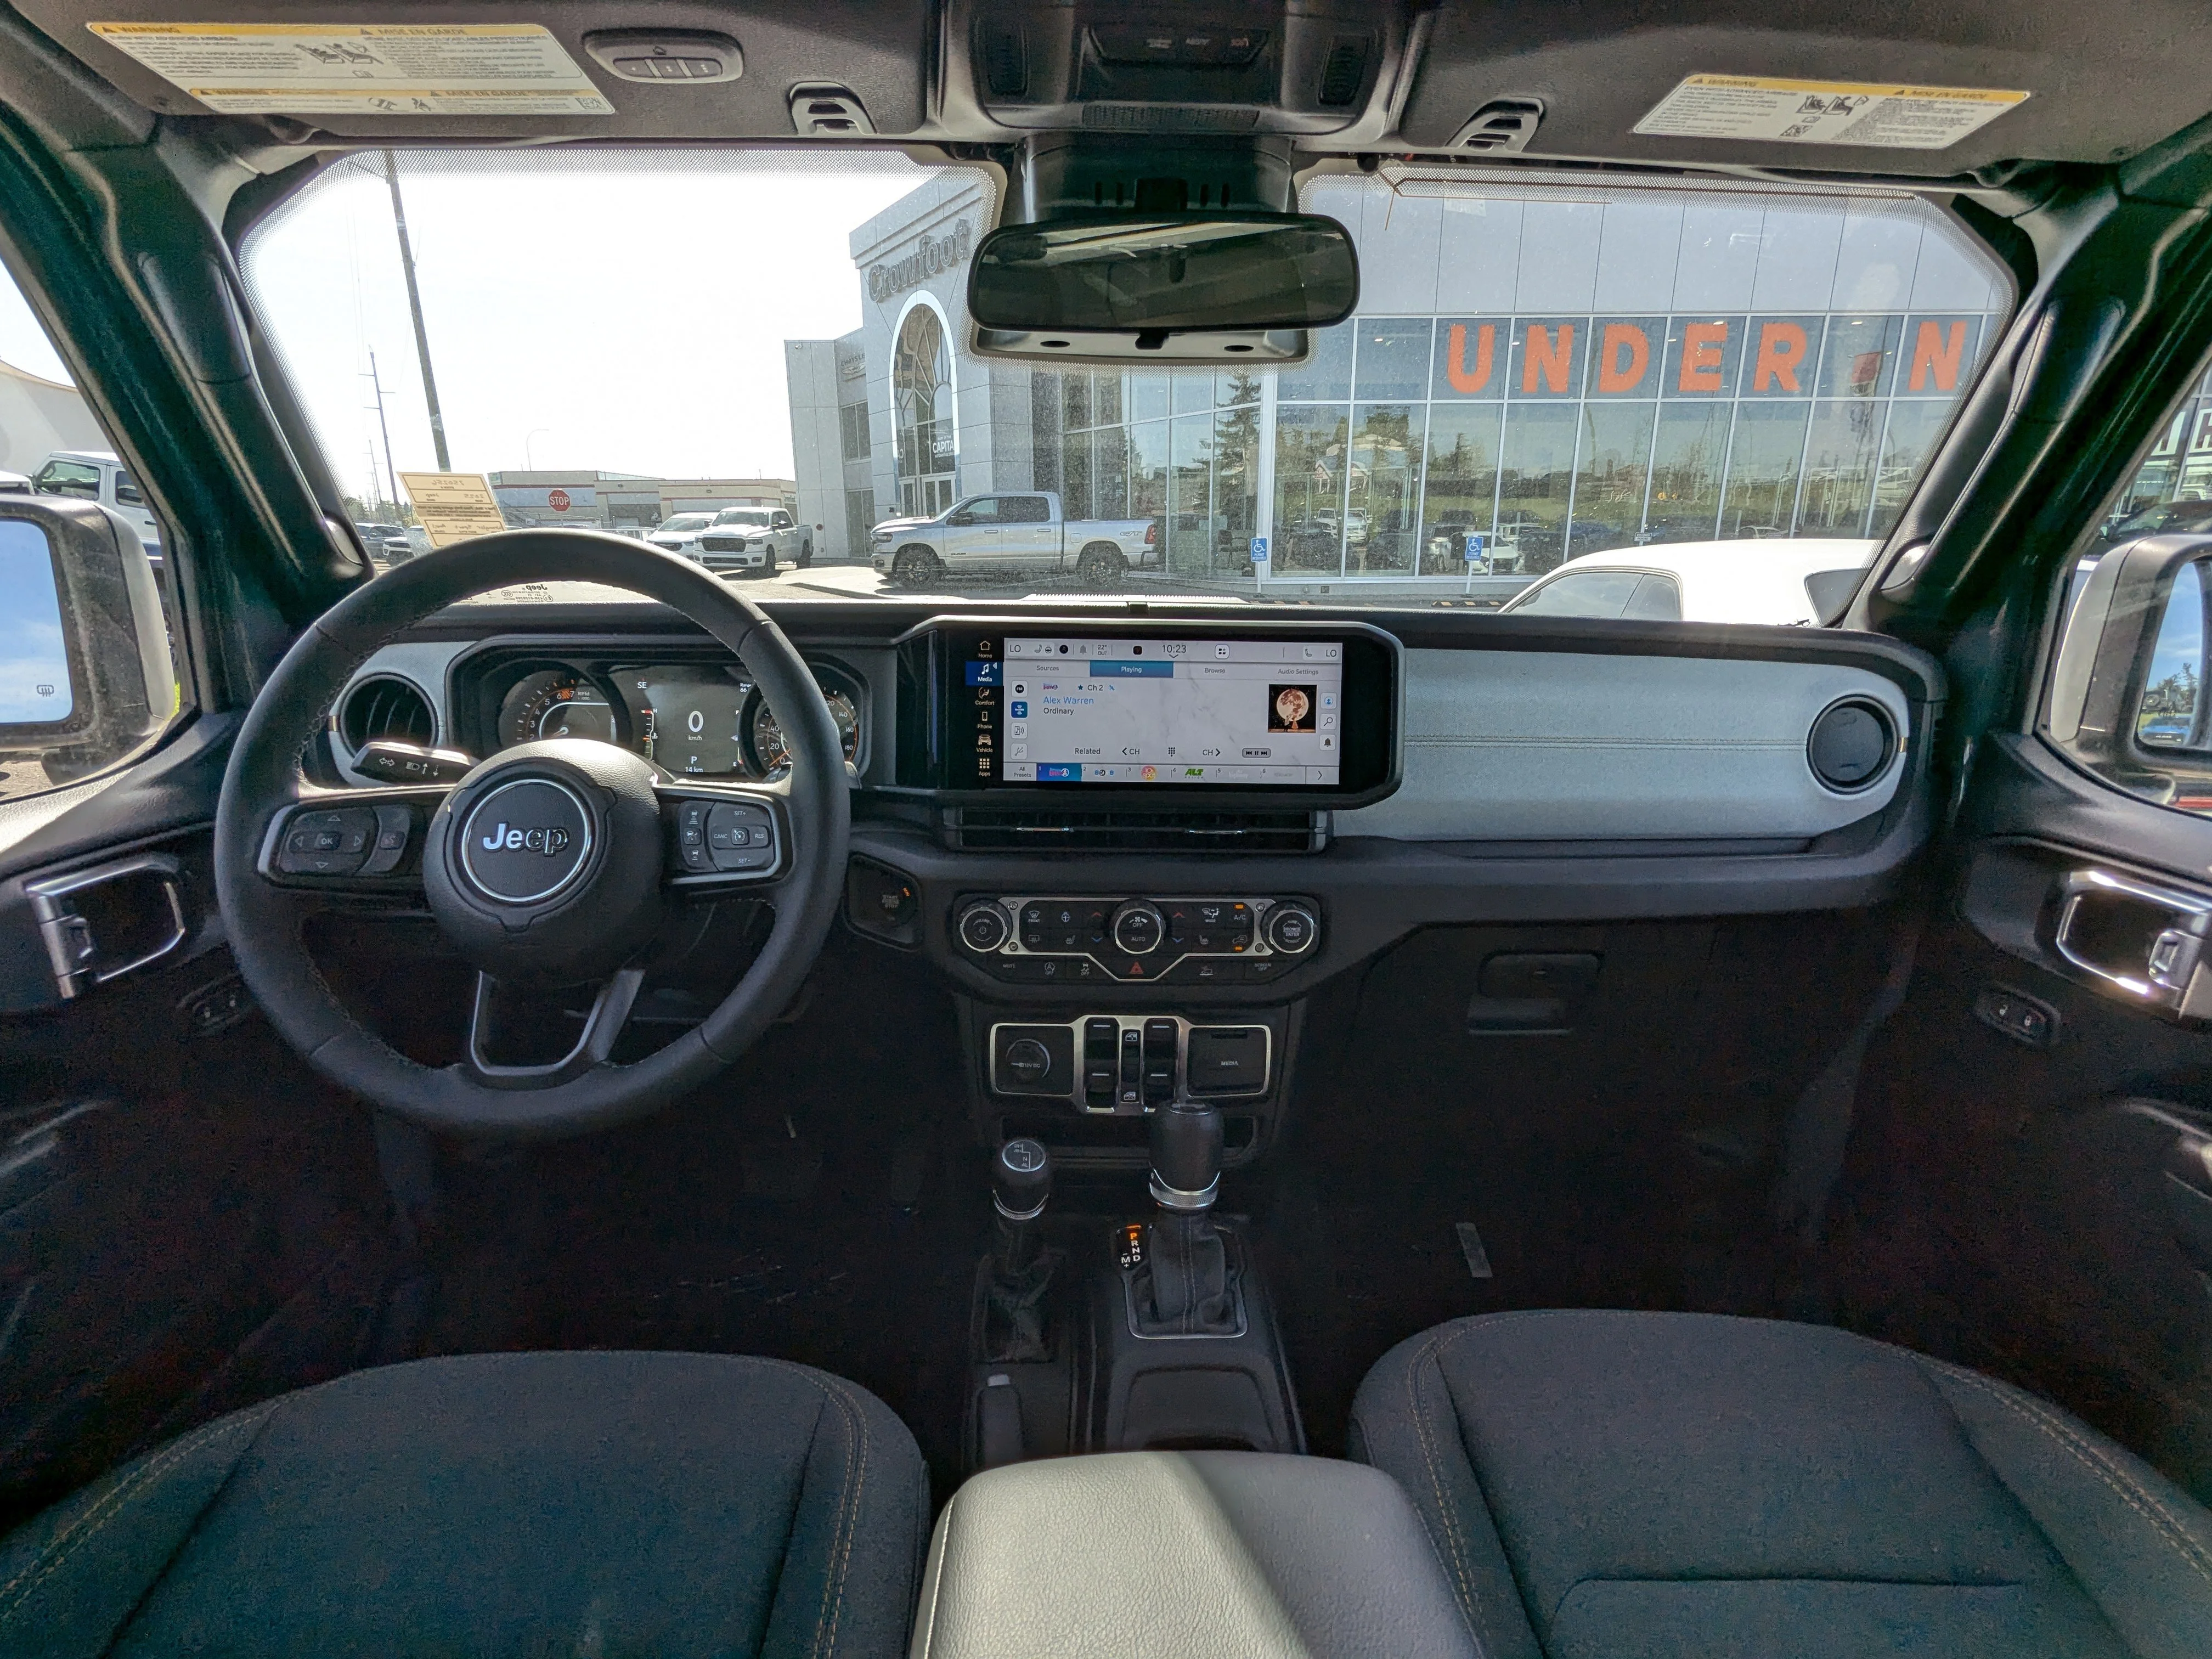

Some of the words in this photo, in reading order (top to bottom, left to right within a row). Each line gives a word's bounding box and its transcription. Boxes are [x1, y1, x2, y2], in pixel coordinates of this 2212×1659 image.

[868, 218, 970, 302] Crowfoot
[840, 353, 865, 367] CHRYSLE
[1447, 323, 1808, 393] UNDER
[933, 440, 955, 453] CAPITA
[550, 496, 569, 505] STOP
[1009, 645, 1022, 653] LO
[1162, 644, 1187, 653] 10:23
[1043, 696, 1061, 704] Alex
[1063, 696, 1094, 705] Warren
[1043, 707, 1075, 716] Ordinary
[688, 710, 704, 732] 0
[691, 756, 697, 764] P
[320, 837, 334, 845] OK
[483, 823, 568, 854] Jeep
